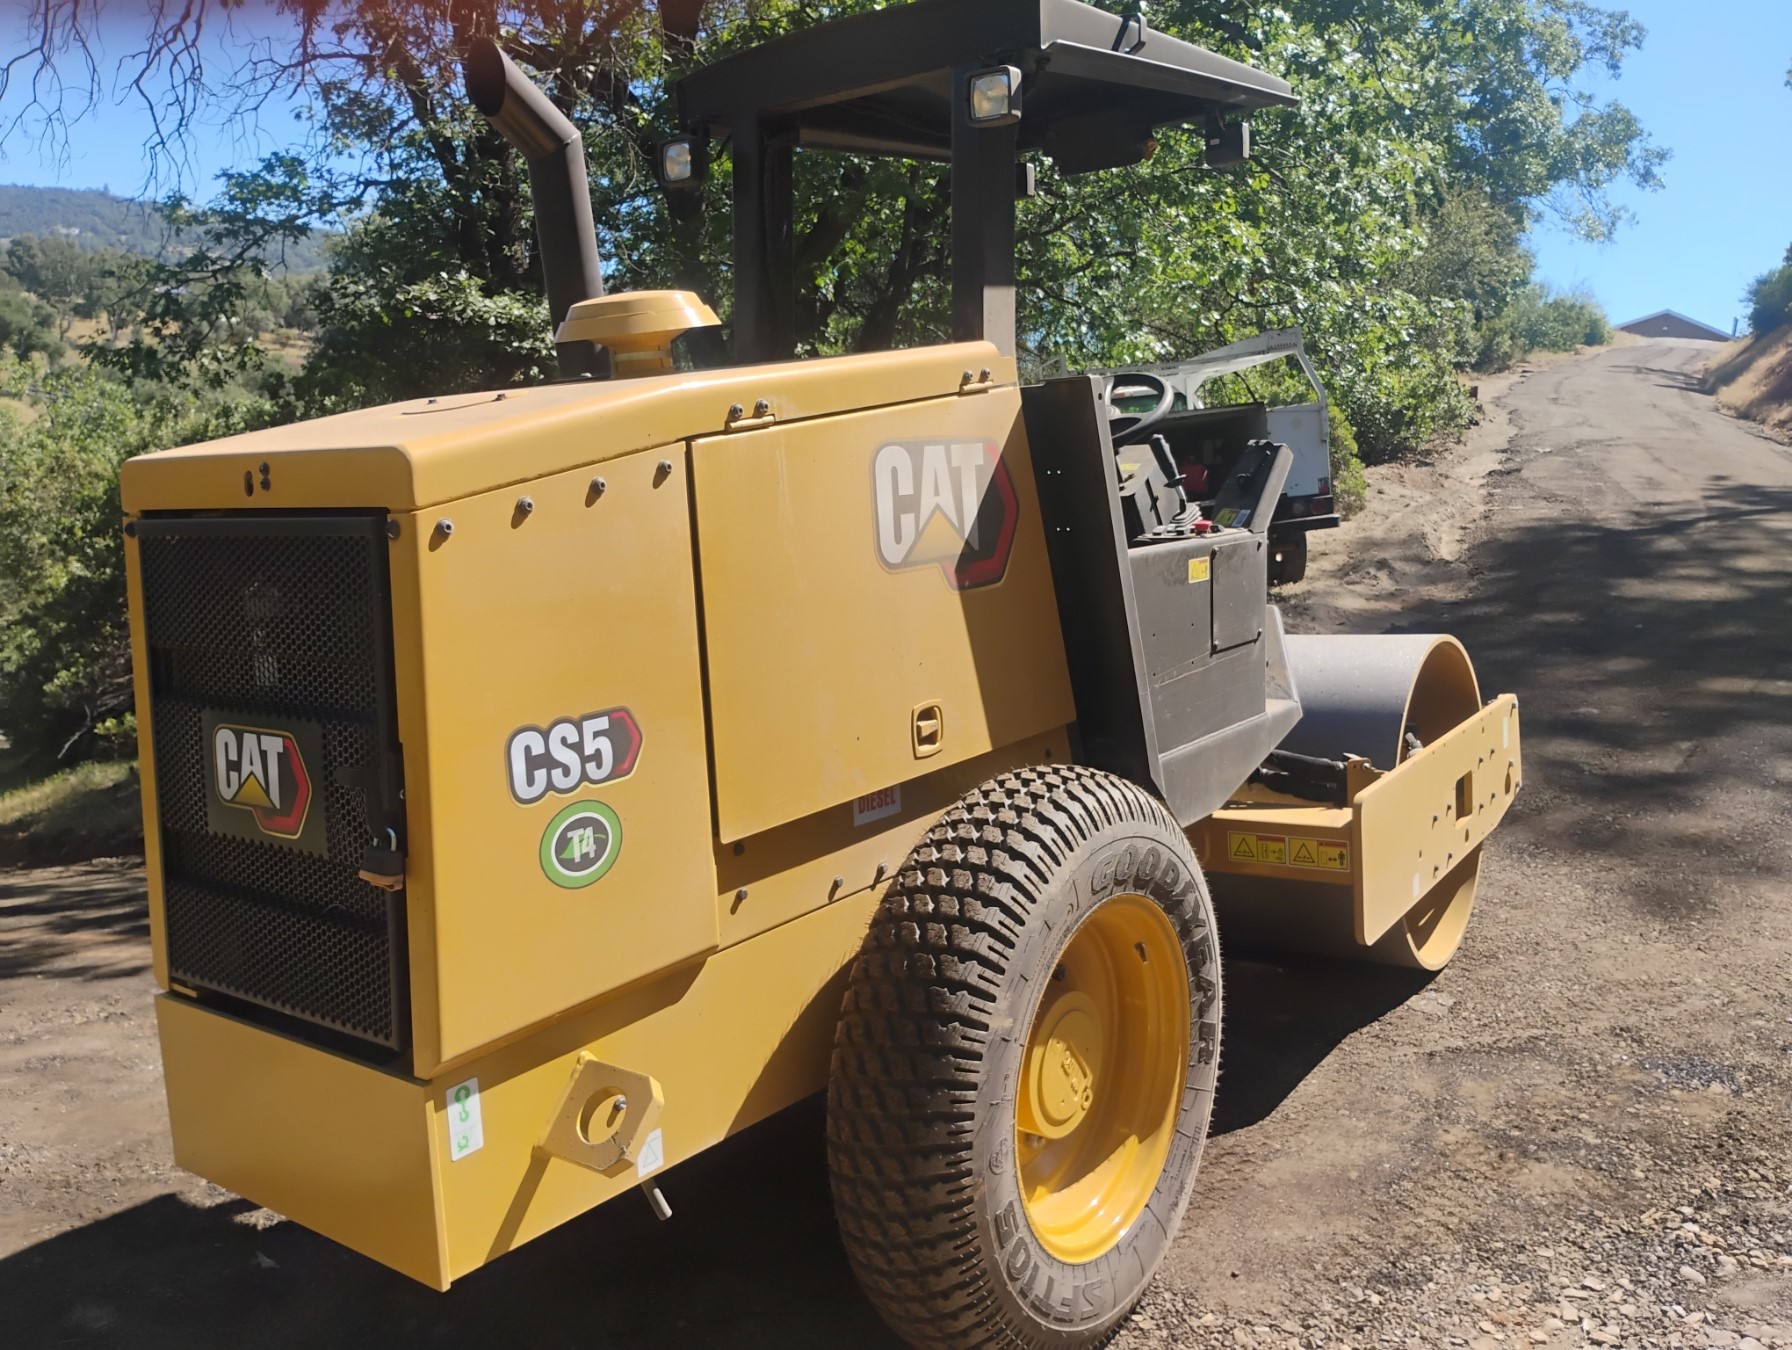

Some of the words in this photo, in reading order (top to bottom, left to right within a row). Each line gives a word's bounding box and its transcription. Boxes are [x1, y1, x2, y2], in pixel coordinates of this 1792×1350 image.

[875, 443, 984, 564] CAT
[215, 728, 283, 810] CAT
[510, 716, 613, 800] CS5
[858, 787, 896, 814] DIESEL
[567, 826, 596, 863] T4
[1091, 843, 1217, 1064] GOODYEAR
